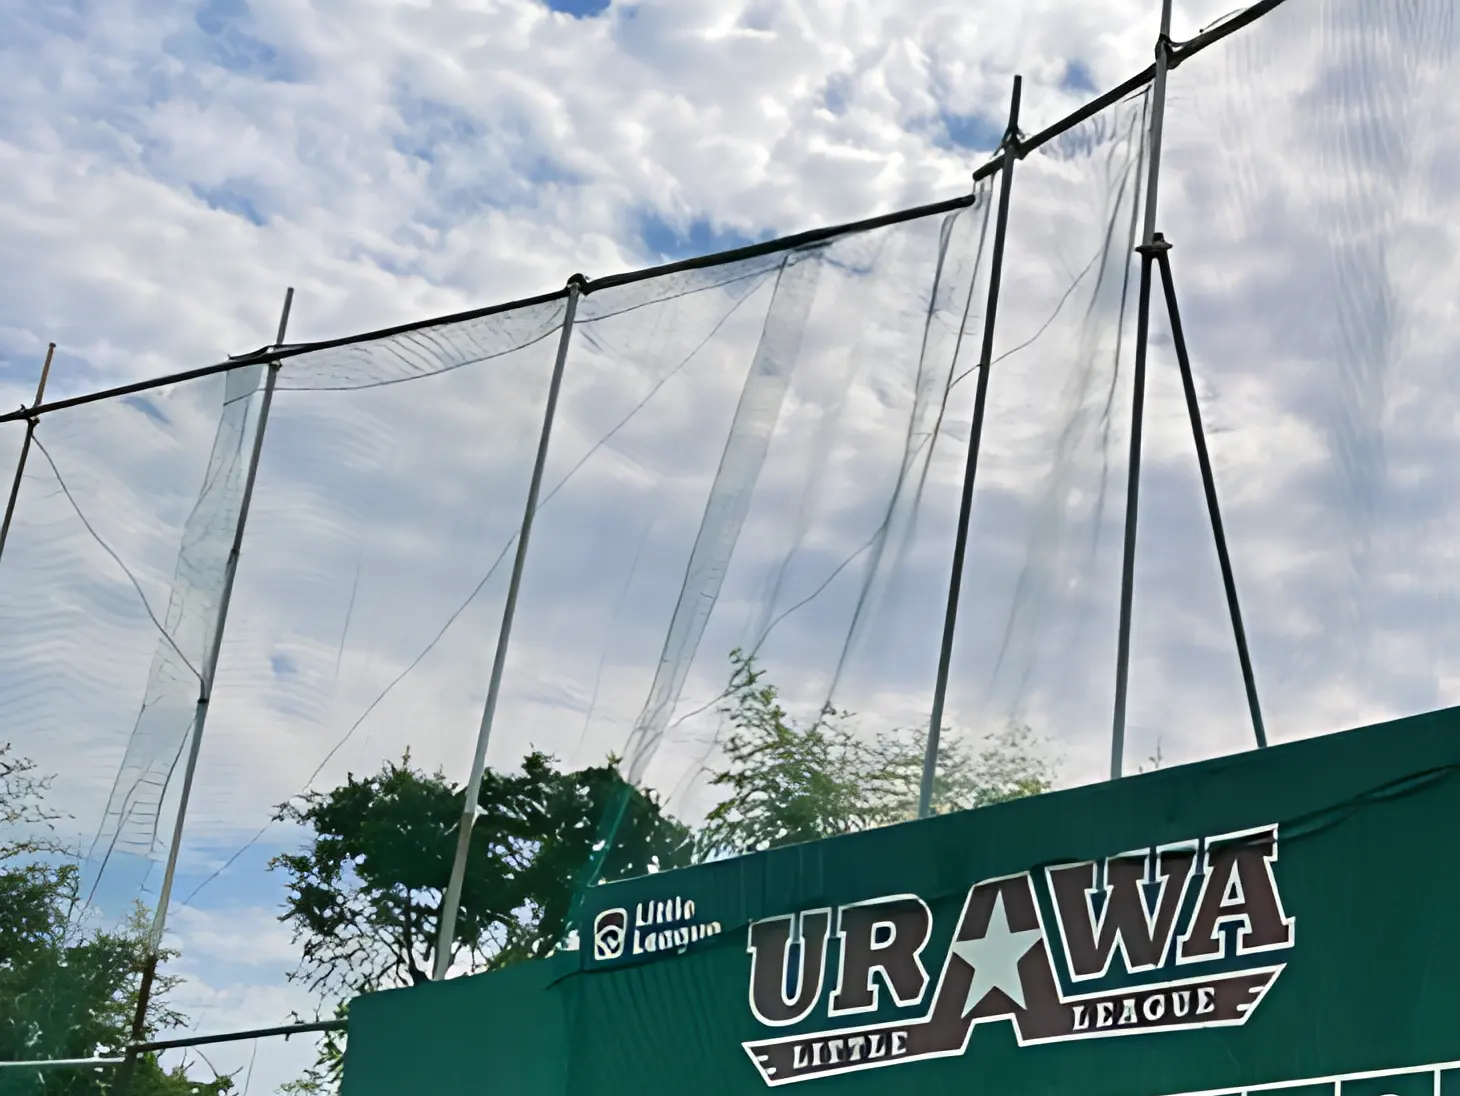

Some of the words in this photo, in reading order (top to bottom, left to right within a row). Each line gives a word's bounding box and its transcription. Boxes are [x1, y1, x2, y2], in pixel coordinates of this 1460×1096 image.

[746, 823, 1296, 1027] URAWA
[793, 1031, 908, 1069] LITTLE
[1072, 987, 1215, 1031] LEAGUE
